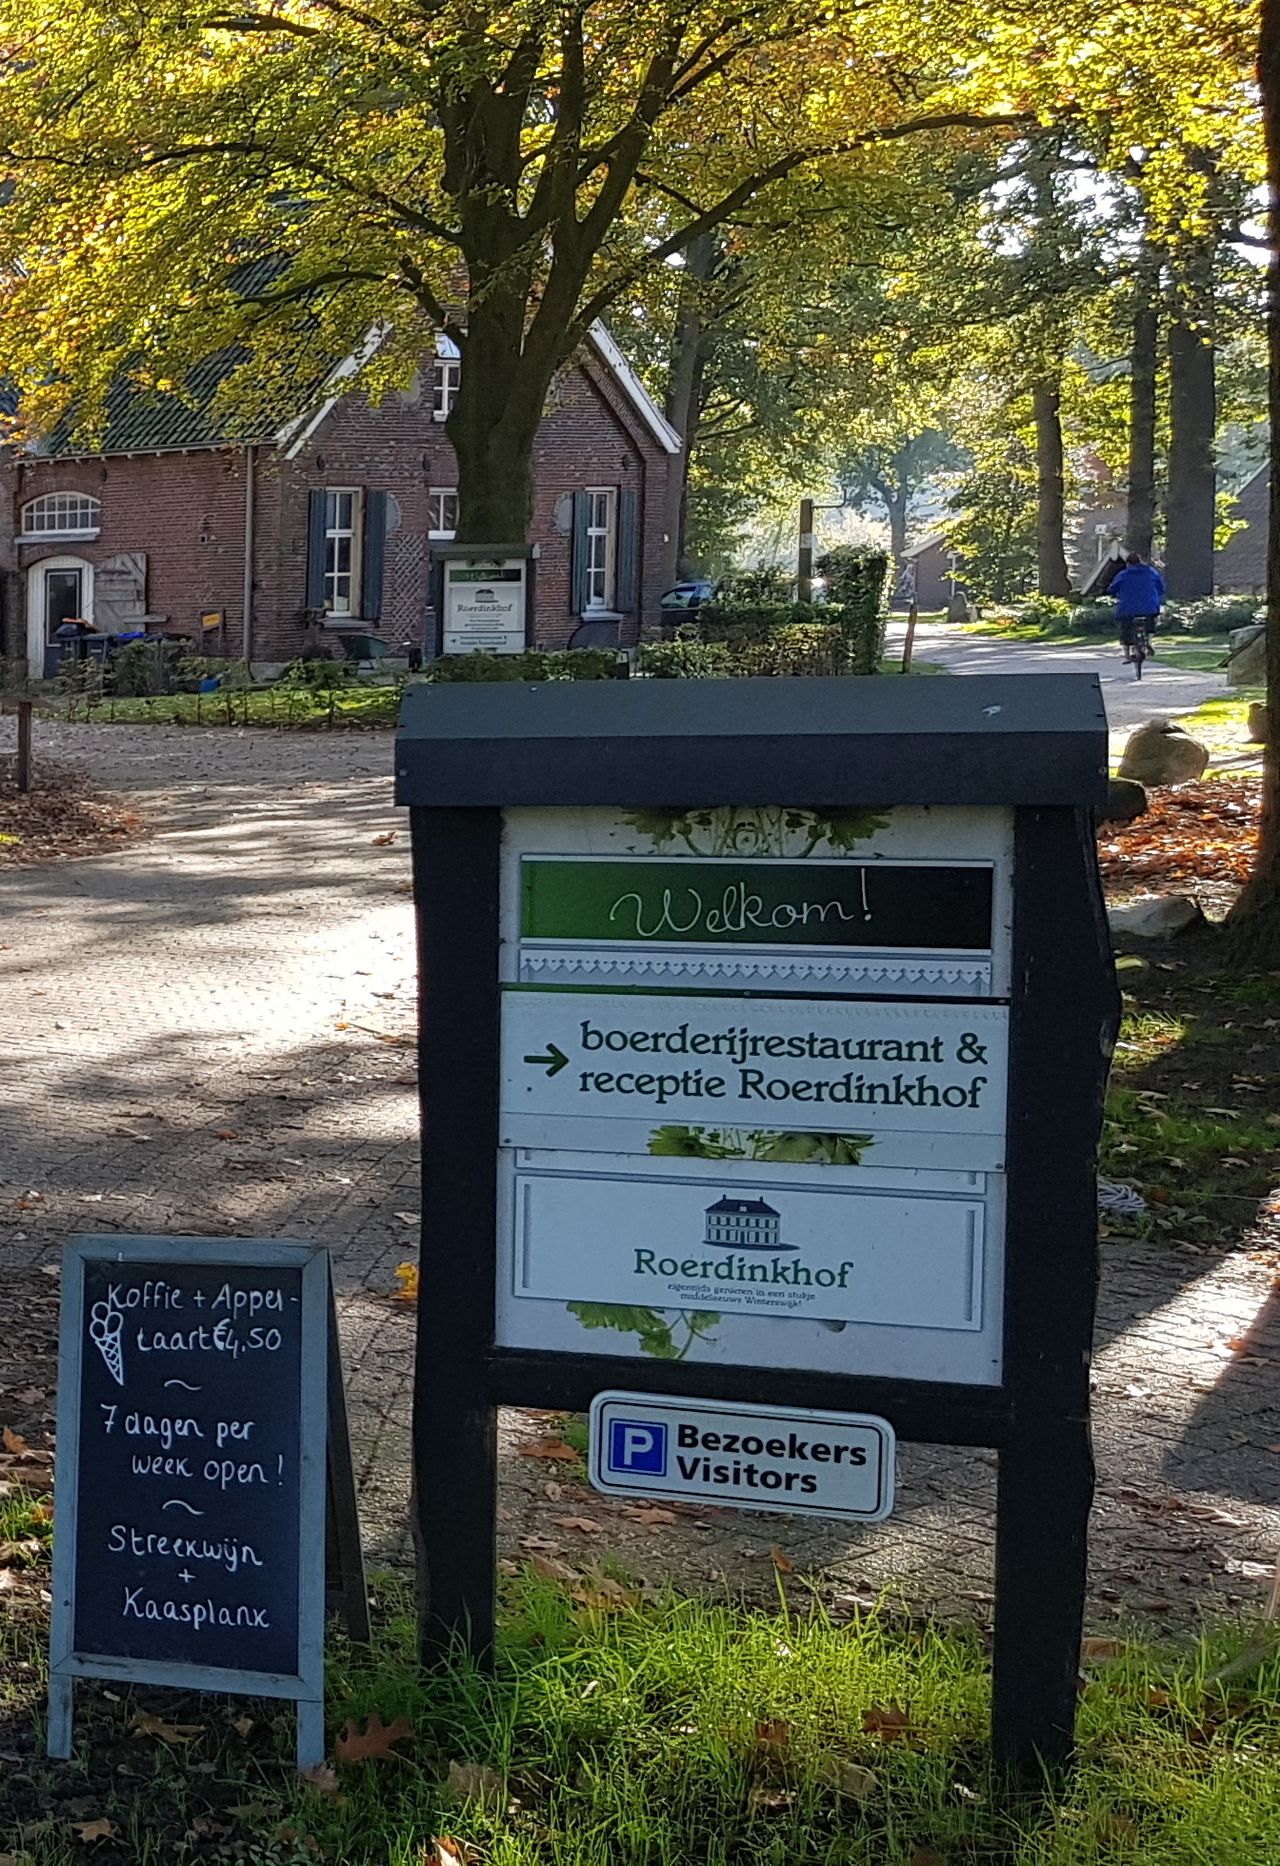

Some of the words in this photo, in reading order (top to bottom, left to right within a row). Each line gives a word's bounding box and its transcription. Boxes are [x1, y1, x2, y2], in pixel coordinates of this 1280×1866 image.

[609, 868, 873, 937] Welkom!
[580, 1020, 944, 1064] boerderijrestaurant
[956, 1031, 989, 1066] &
[579, 1068, 727, 1104] receptie
[738, 1068, 988, 1108] Roerdinkhof
[633, 1248, 854, 1288] Roerdinkhof
[108, 1281, 184, 1310] Koffie
[193, 1289, 206, 1308] +
[100, 1403, 118, 1434] 7
[125, 1412, 204, 1450] dagen
[216, 1420, 256, 1448] per
[677, 1424, 867, 1466] Bezoekers
[131, 1455, 194, 1478] week
[676, 1455, 818, 1493] Visitors
[108, 1525, 264, 1572] Streekwijn
[178, 1568, 196, 1583] +
[122, 1586, 270, 1630] Kaasplank
